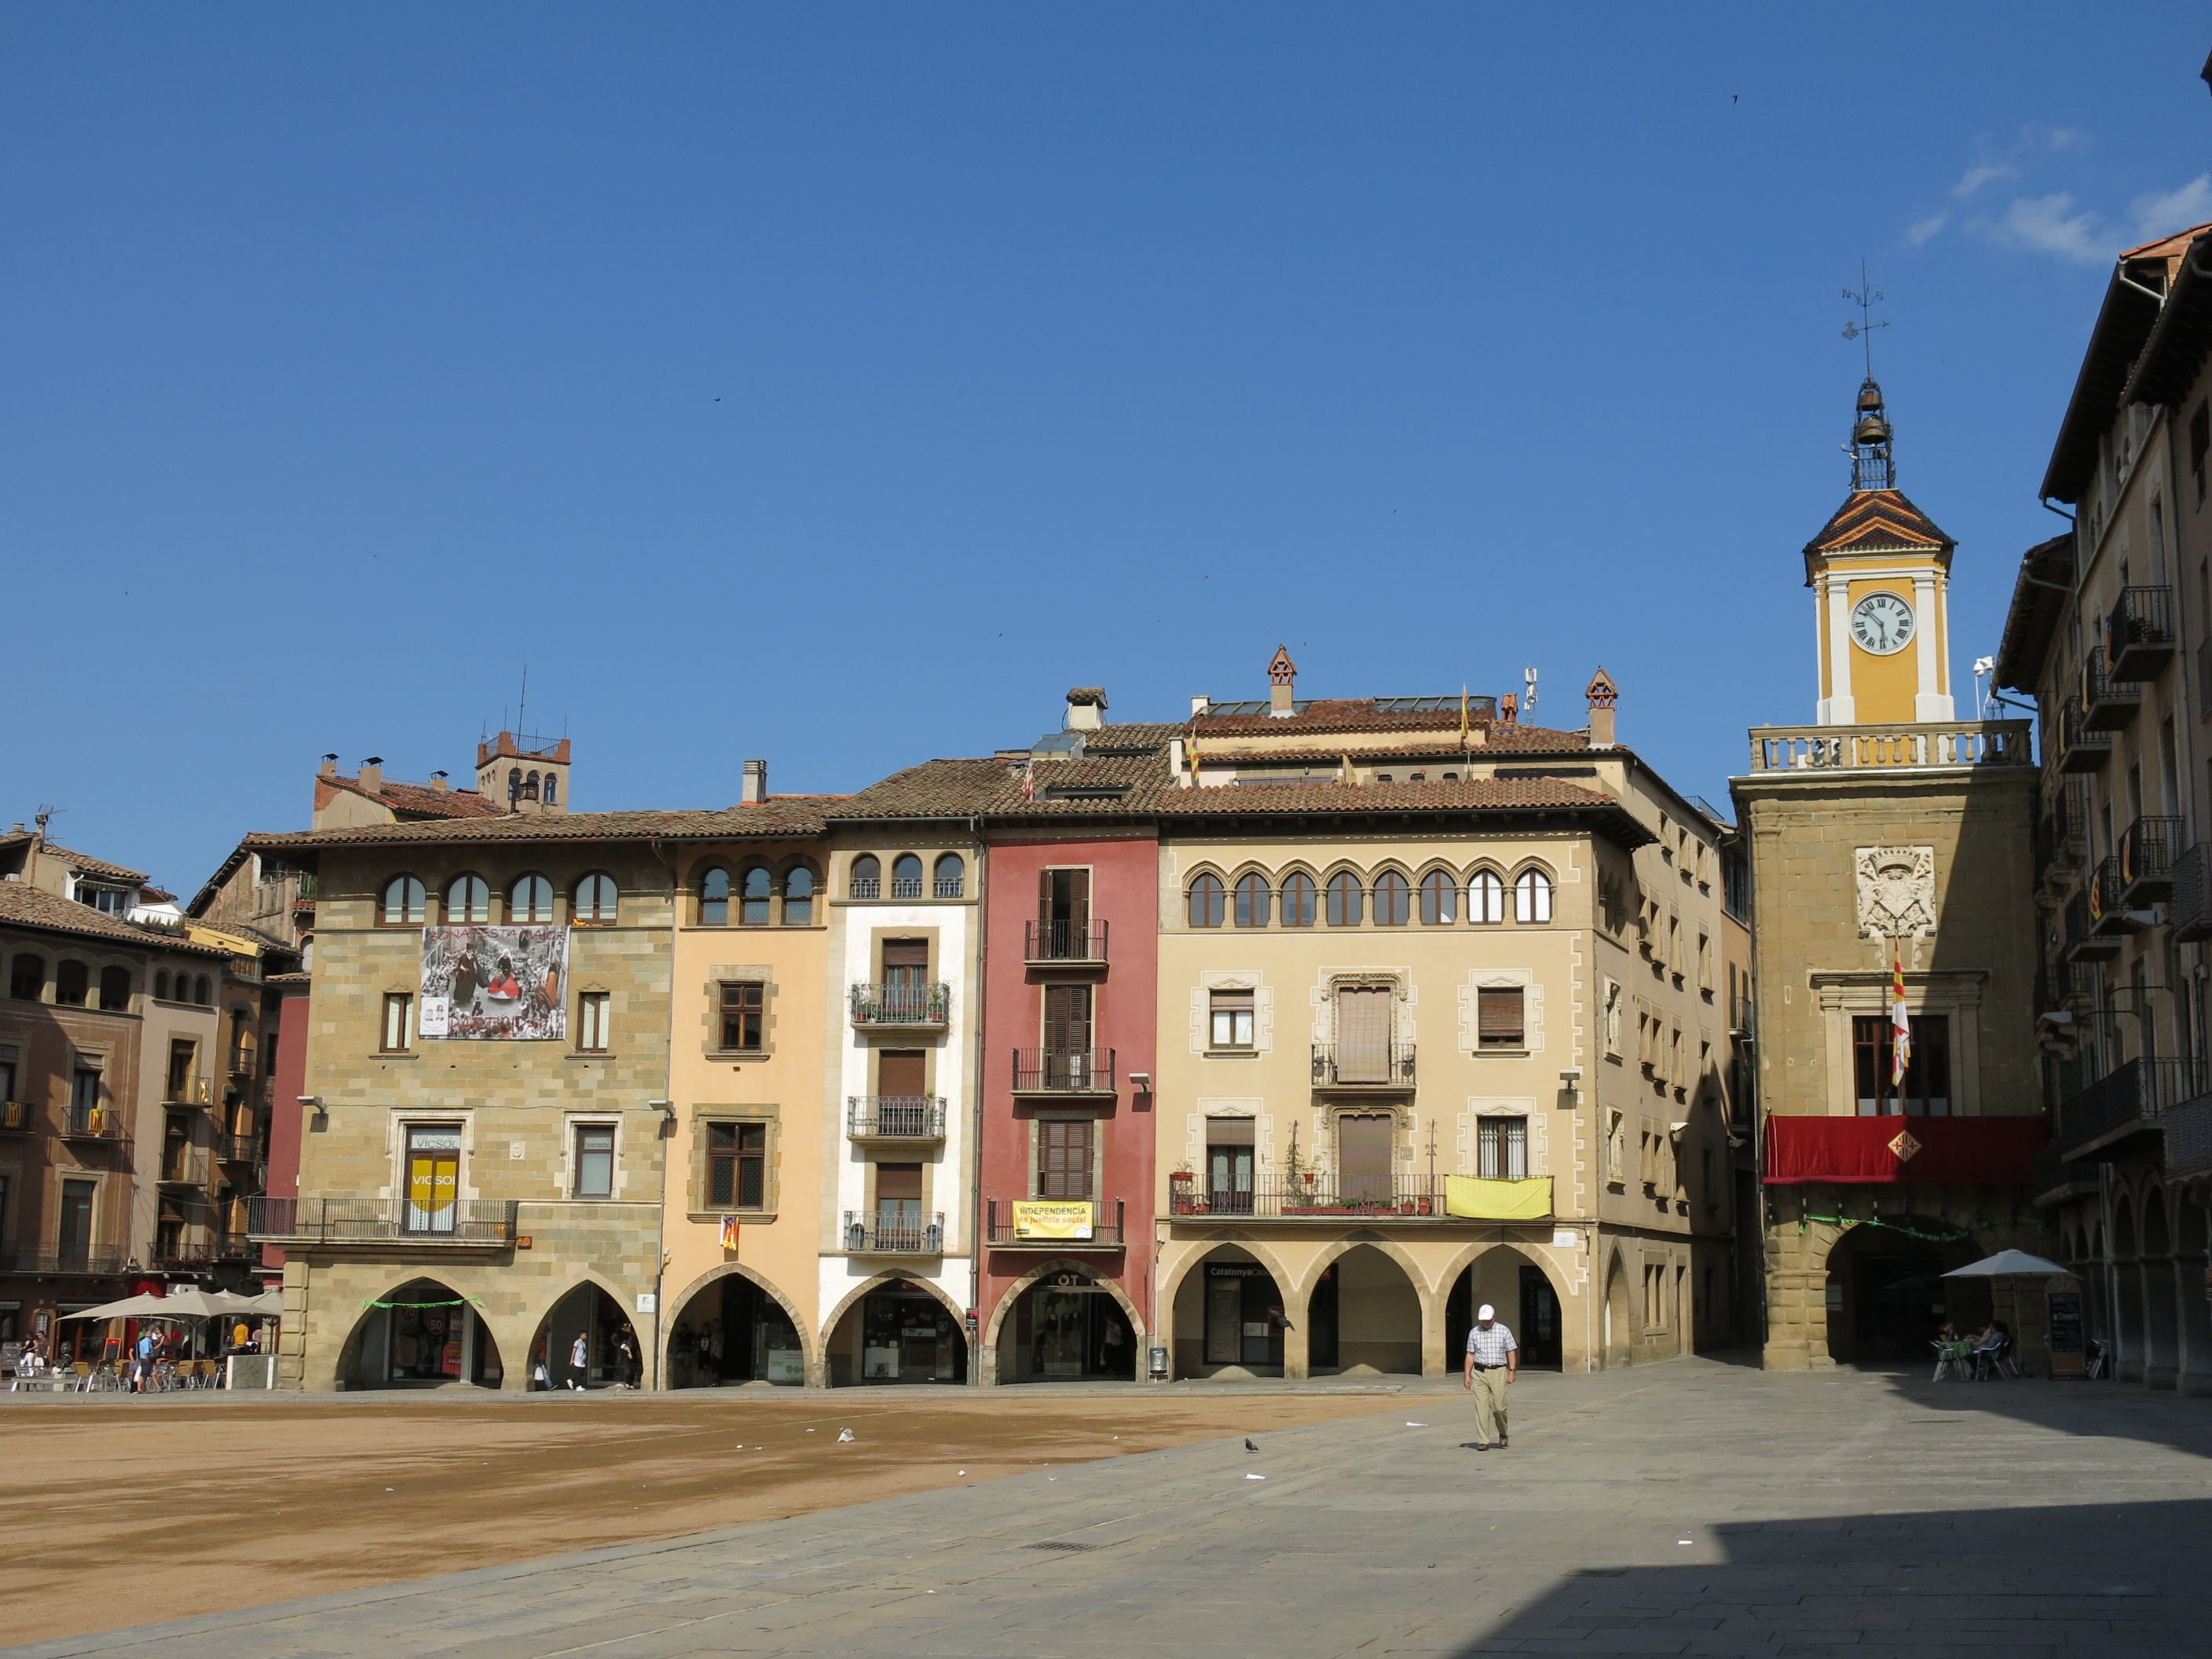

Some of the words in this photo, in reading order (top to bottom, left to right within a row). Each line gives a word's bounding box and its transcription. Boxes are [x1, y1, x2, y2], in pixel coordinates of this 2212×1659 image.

[1842, 289, 1851, 298] N
[1876, 291, 1884, 300] S
[429, 929, 470, 942] BONA
[473, 928, 518, 939] FESTA
[522, 930, 567, 943] MAJOR
[417, 1140, 458, 1148] VICSOL
[1020, 1205, 1086, 1215] INDEPENDÈNCIA
[430, 1319, 442, 1330] 50
